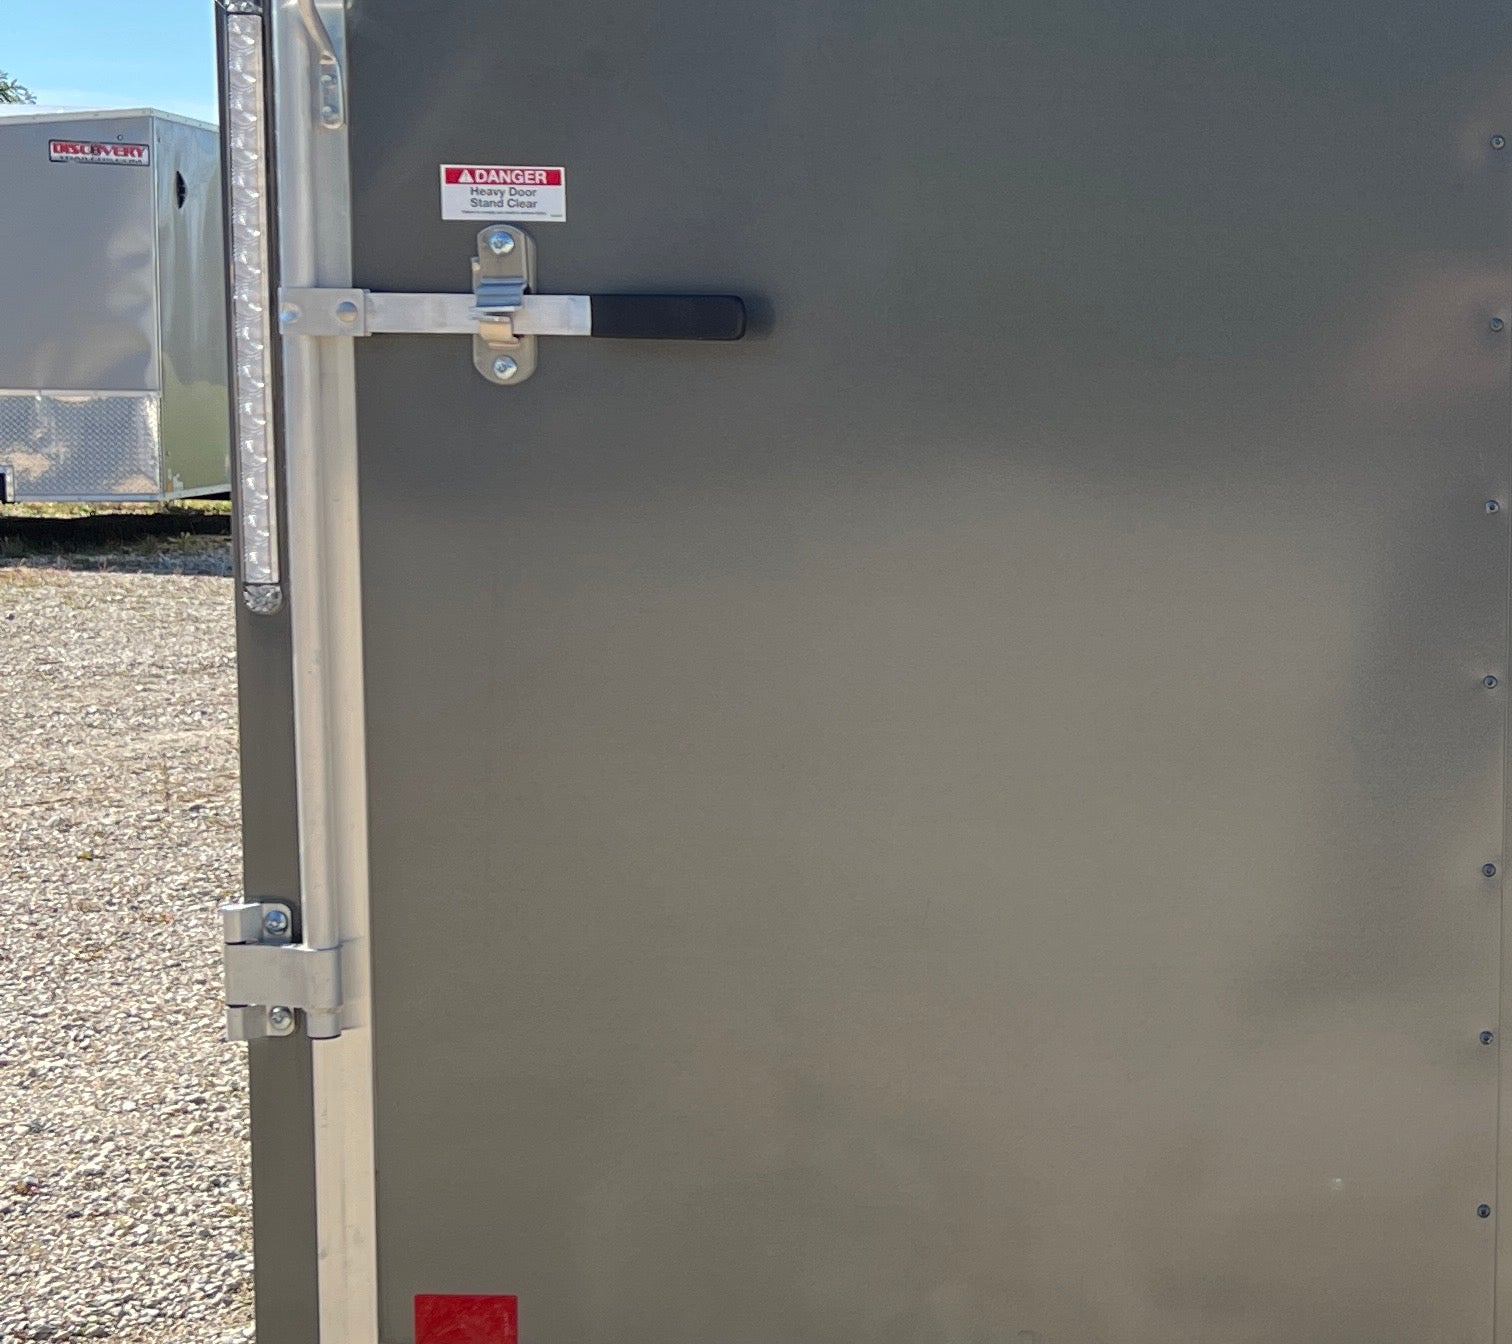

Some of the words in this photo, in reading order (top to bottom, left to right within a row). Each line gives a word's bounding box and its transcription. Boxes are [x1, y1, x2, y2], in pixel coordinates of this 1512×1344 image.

[475, 169, 547, 185] DANGER
[470, 186, 506, 199] Heavy
[509, 187, 537, 197] Door
[470, 197, 504, 208] Stand
[507, 198, 538, 209] Clear
